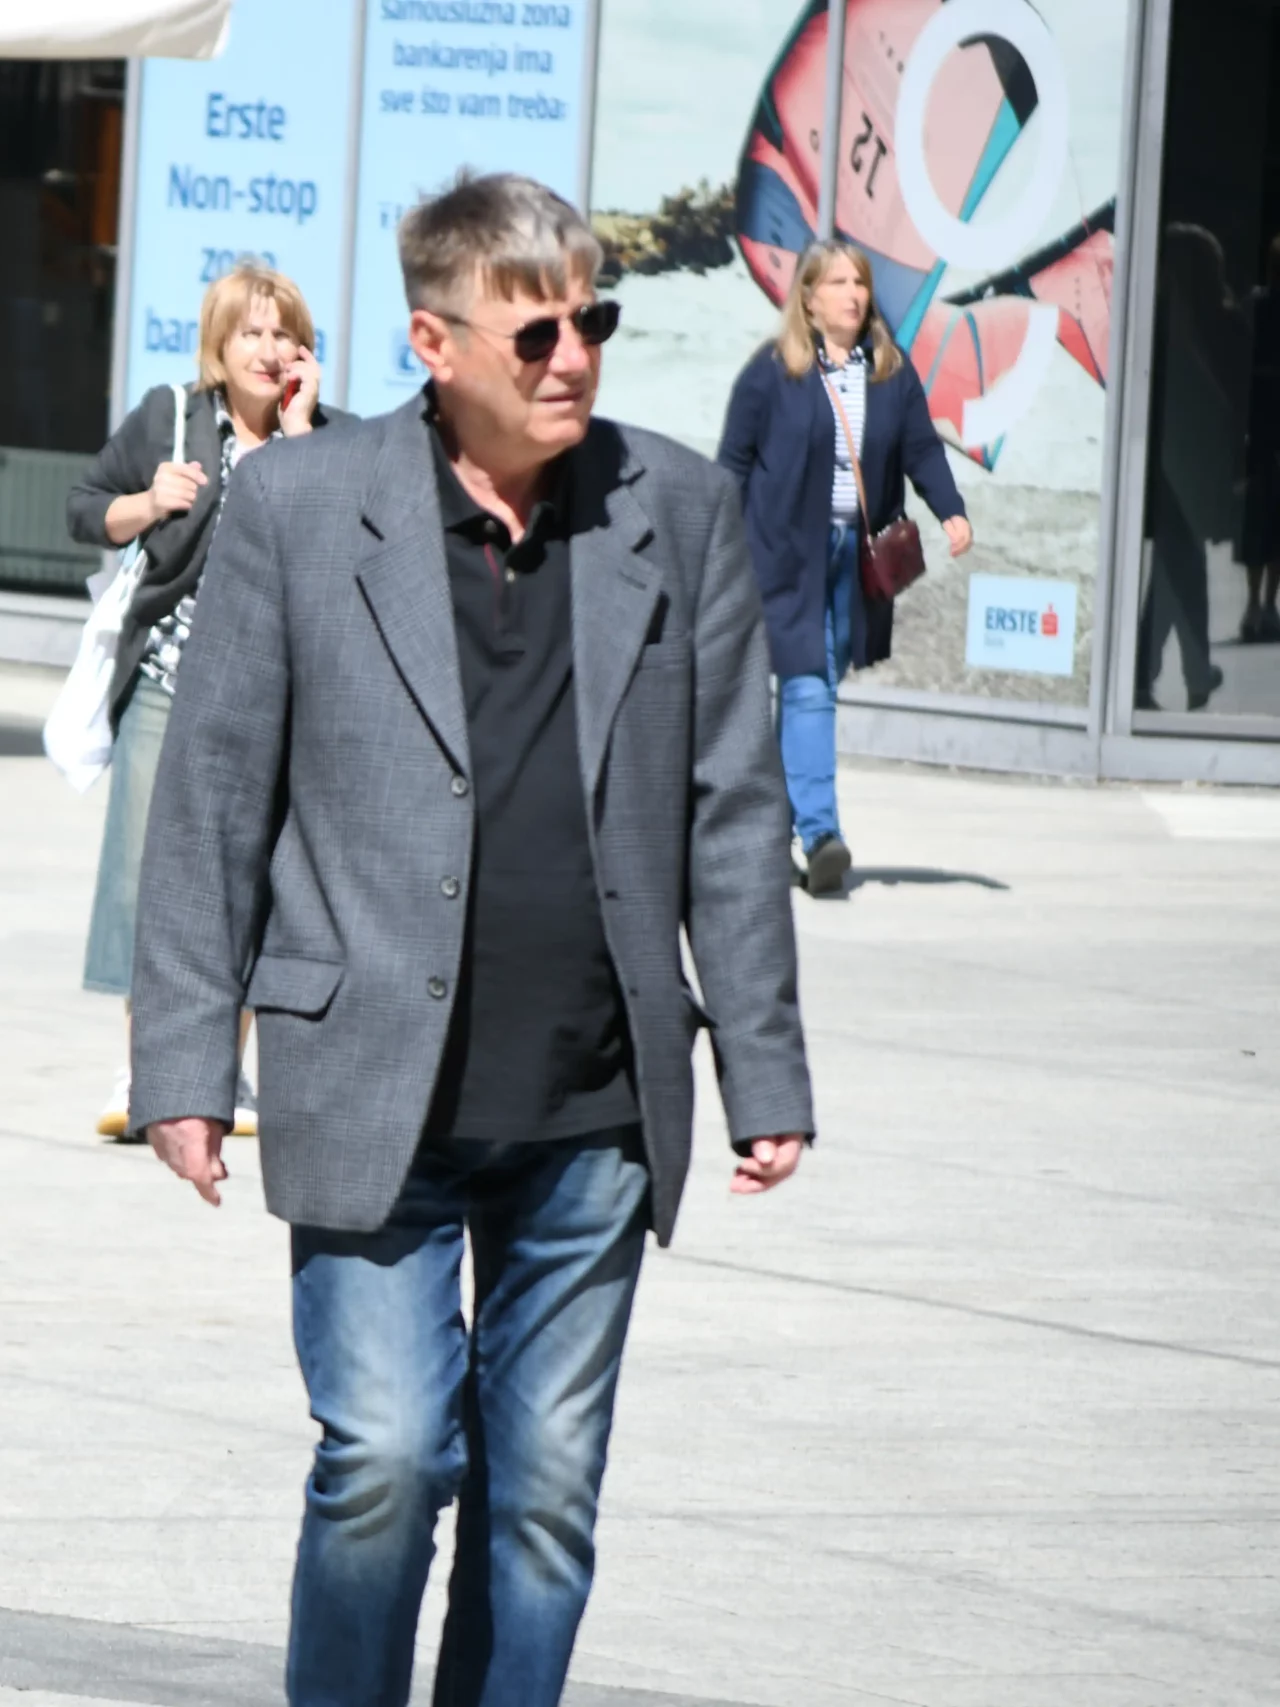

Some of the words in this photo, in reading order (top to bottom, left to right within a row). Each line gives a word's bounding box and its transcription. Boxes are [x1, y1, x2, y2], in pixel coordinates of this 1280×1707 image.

[522, 4, 570, 27] zona
[393, 38, 508, 77] bankarenja
[514, 42, 554, 73] ima
[206, 92, 286, 141] Erste
[380, 89, 414, 113] sve
[458, 93, 501, 116] vam
[167, 163, 317, 226] Non-stop
[984, 606, 1038, 635] ERSTE
